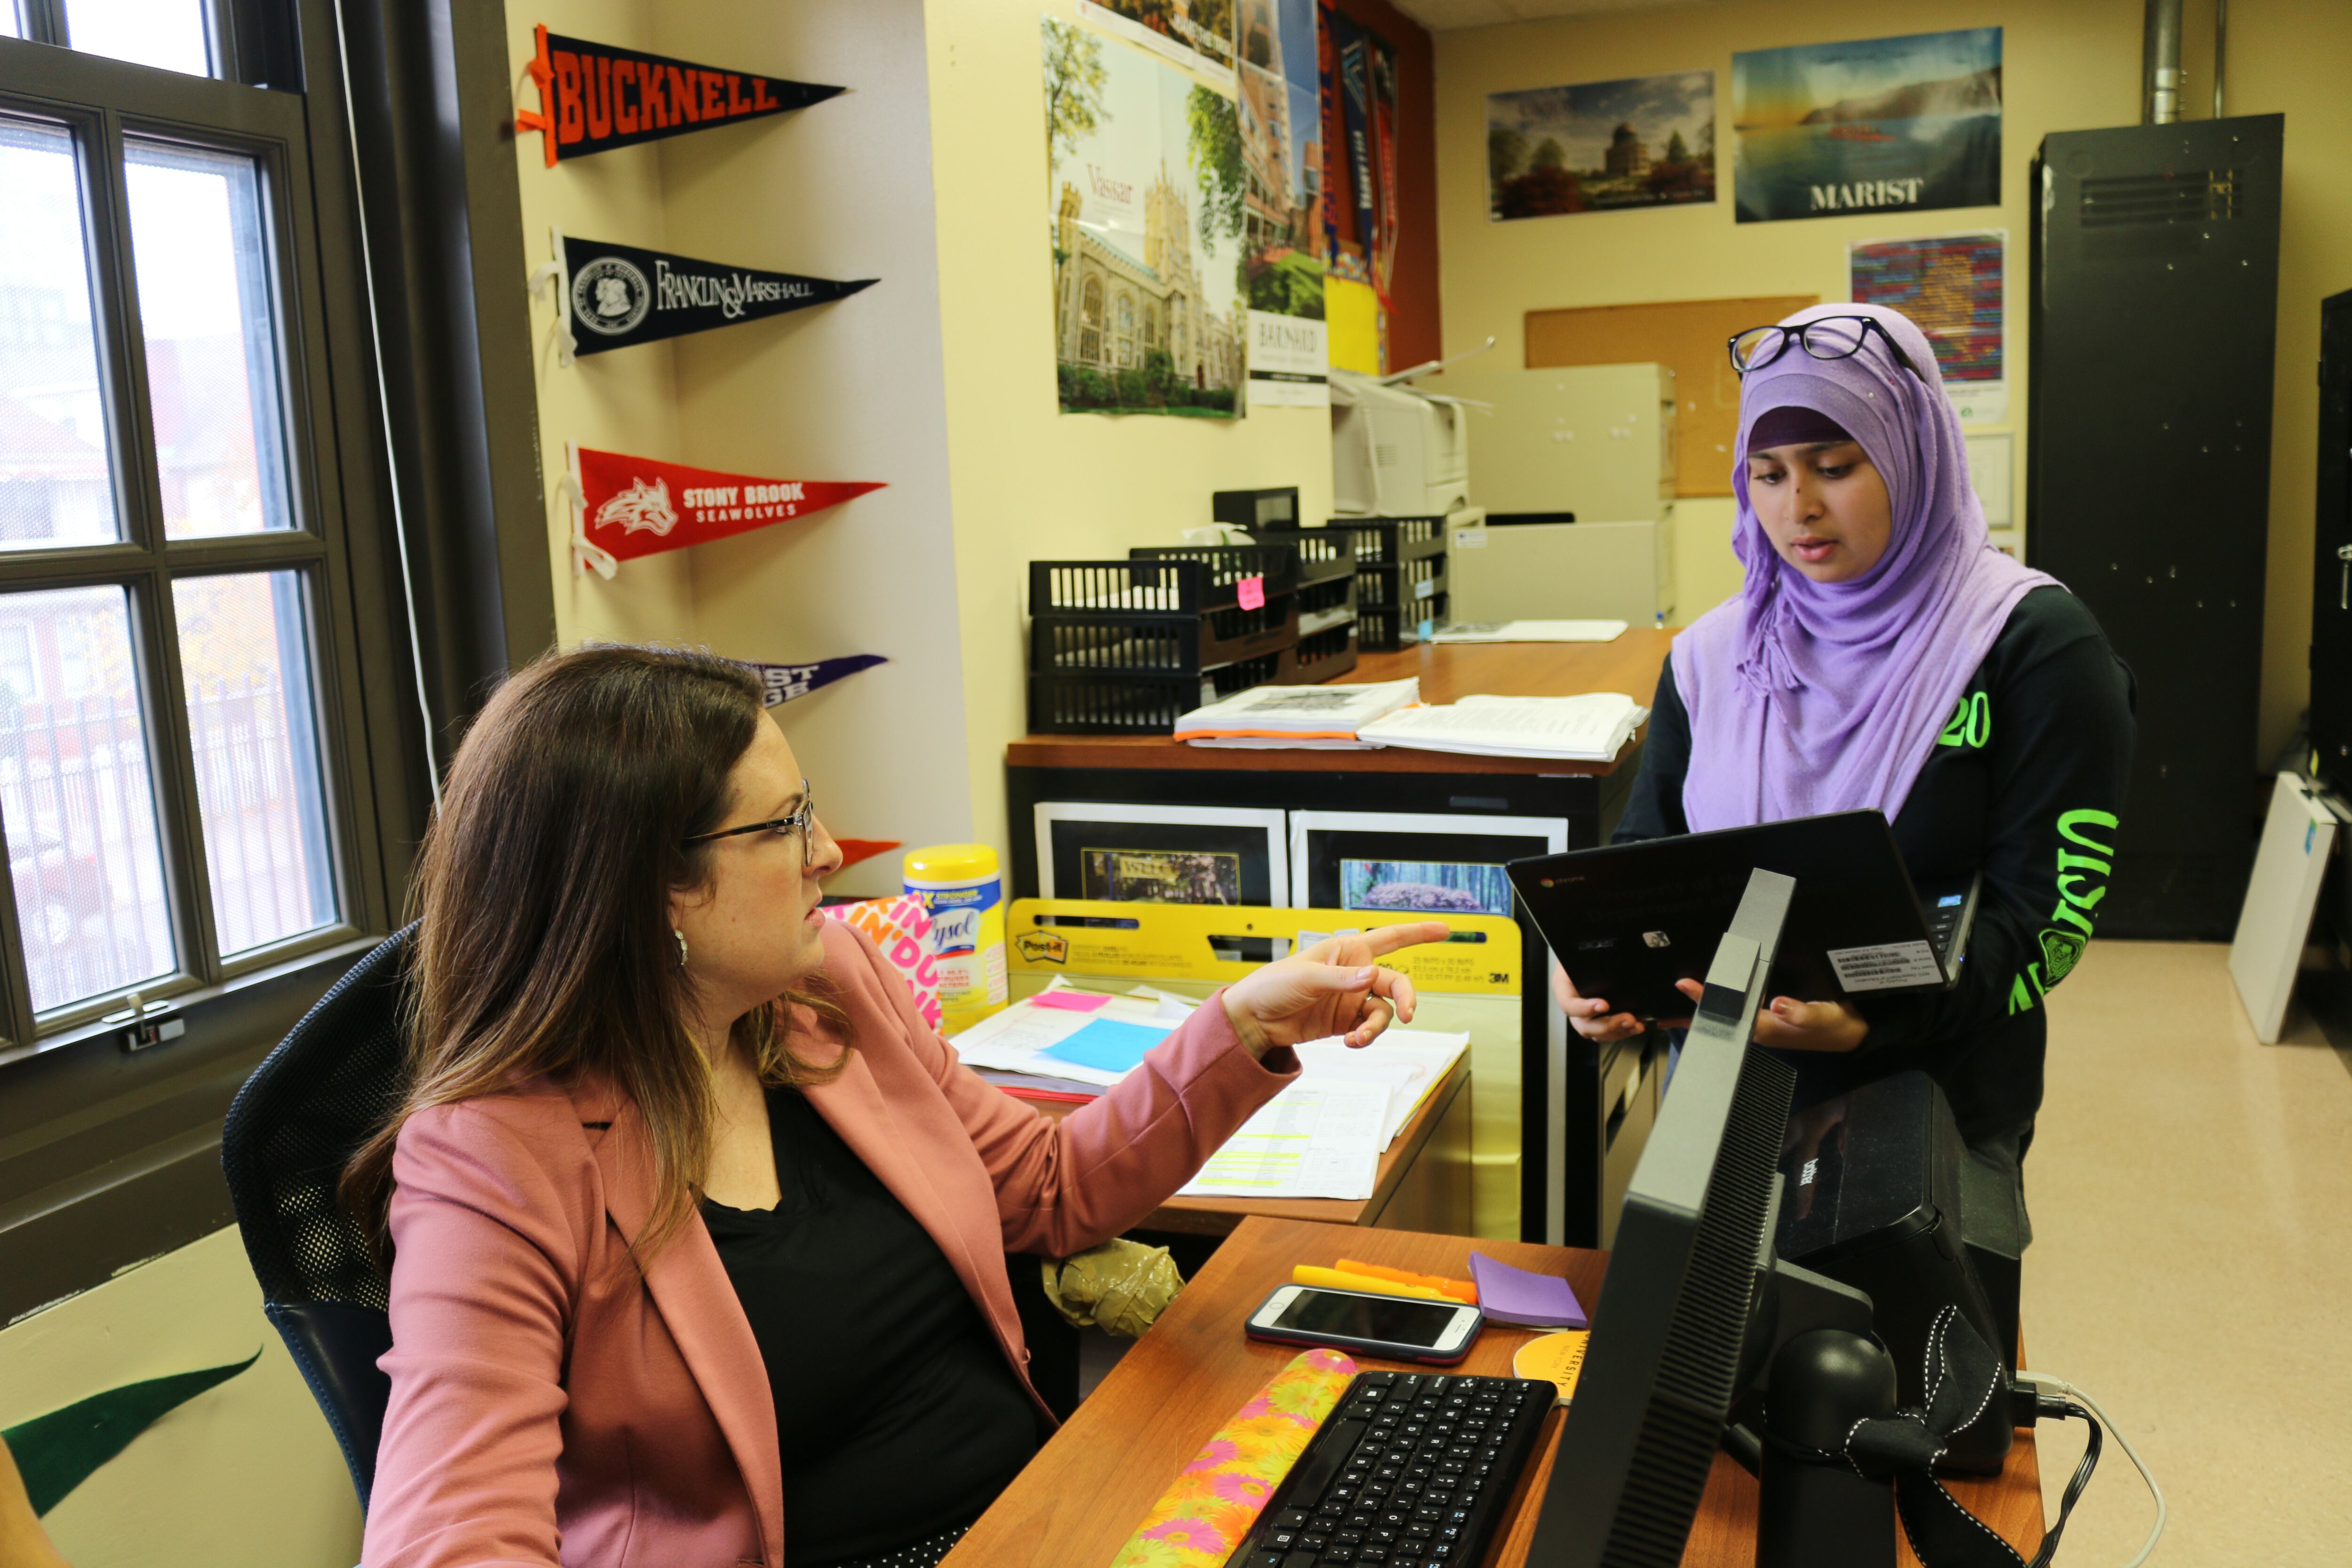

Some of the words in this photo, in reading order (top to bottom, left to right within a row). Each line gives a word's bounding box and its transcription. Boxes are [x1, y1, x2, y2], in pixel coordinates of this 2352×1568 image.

[553, 50, 779, 145] BUCKNELL
[1086, 164, 1133, 204] Vassar
[1810, 178, 1924, 211] MARIST
[655, 260, 728, 310] FRANKLIN
[732, 272, 815, 303] MARSHALL
[1259, 323, 1317, 352] BARNARD
[683, 487, 739, 508] STONY
[744, 482, 805, 504] BROOK
[695, 503, 796, 523] SEAWOLVES
[1555, 875, 1586, 885] chrome
[1023, 940, 1063, 953] Post-it
[1489, 973, 1510, 984] 3M
